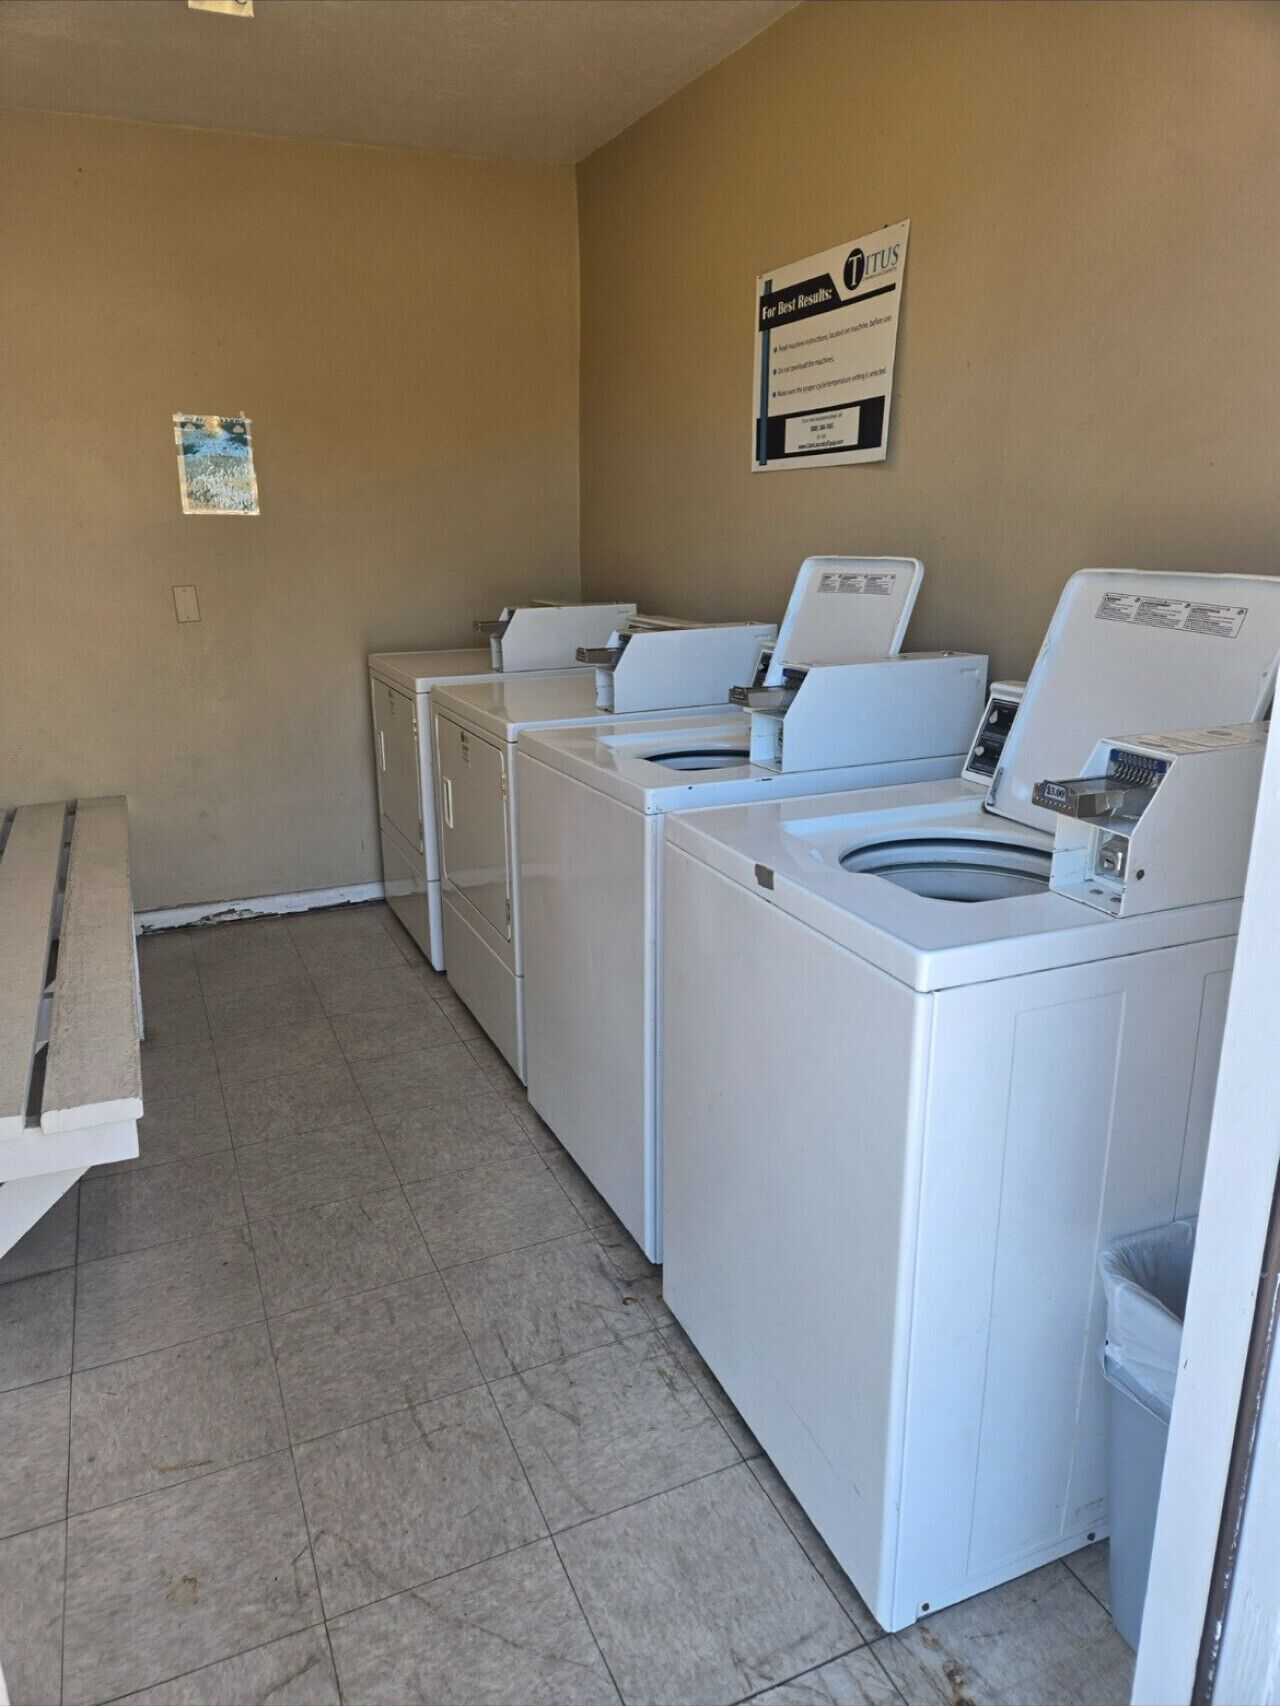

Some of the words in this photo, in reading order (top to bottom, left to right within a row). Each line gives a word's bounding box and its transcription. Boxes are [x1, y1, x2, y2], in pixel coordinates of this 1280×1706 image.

[848, 243, 900, 287] TITUS
[761, 305, 776, 320] For
[777, 299, 796, 315] Best
[797, 286, 832, 309] Results:
